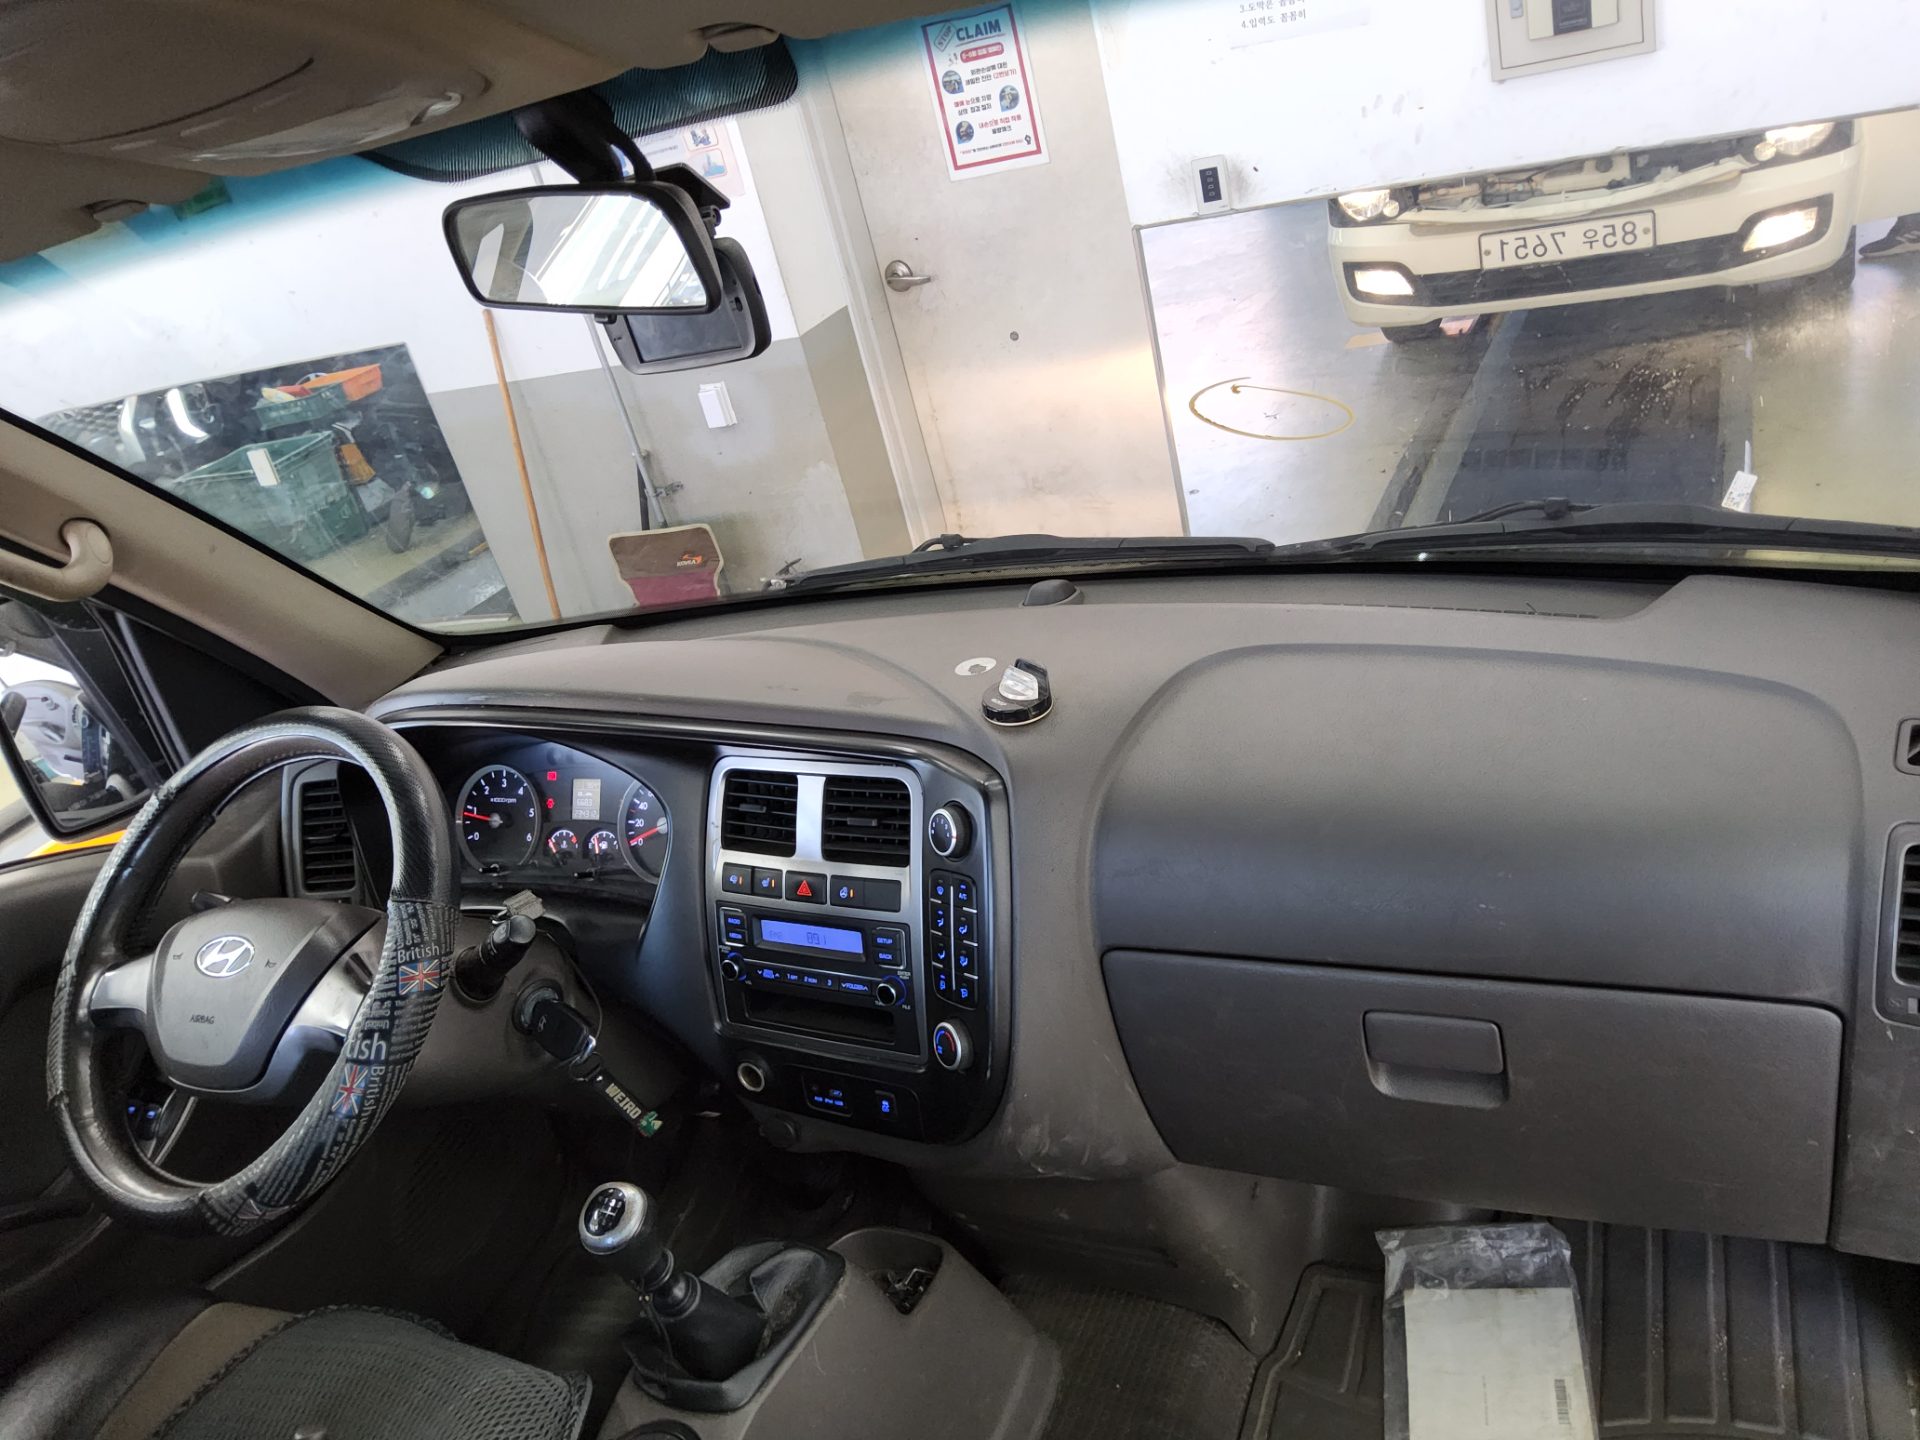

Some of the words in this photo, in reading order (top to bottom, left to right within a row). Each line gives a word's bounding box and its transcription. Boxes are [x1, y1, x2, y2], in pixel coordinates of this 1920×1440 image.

[956, 19, 1002, 41] CLAIM
[502, 779, 508, 788] 3
[484, 786, 490, 795] 2
[517, 787, 524, 796] 4
[638, 801, 648, 810] 40
[528, 808, 535, 818] 5
[635, 819, 644, 828] 20
[473, 832, 480, 841] 0
[526, 833, 532, 842] 6
[638, 838, 643, 846] 0
[397, 942, 440, 964] British
[878, 953, 893, 961] BACK
[363, 1065, 386, 1117] British
